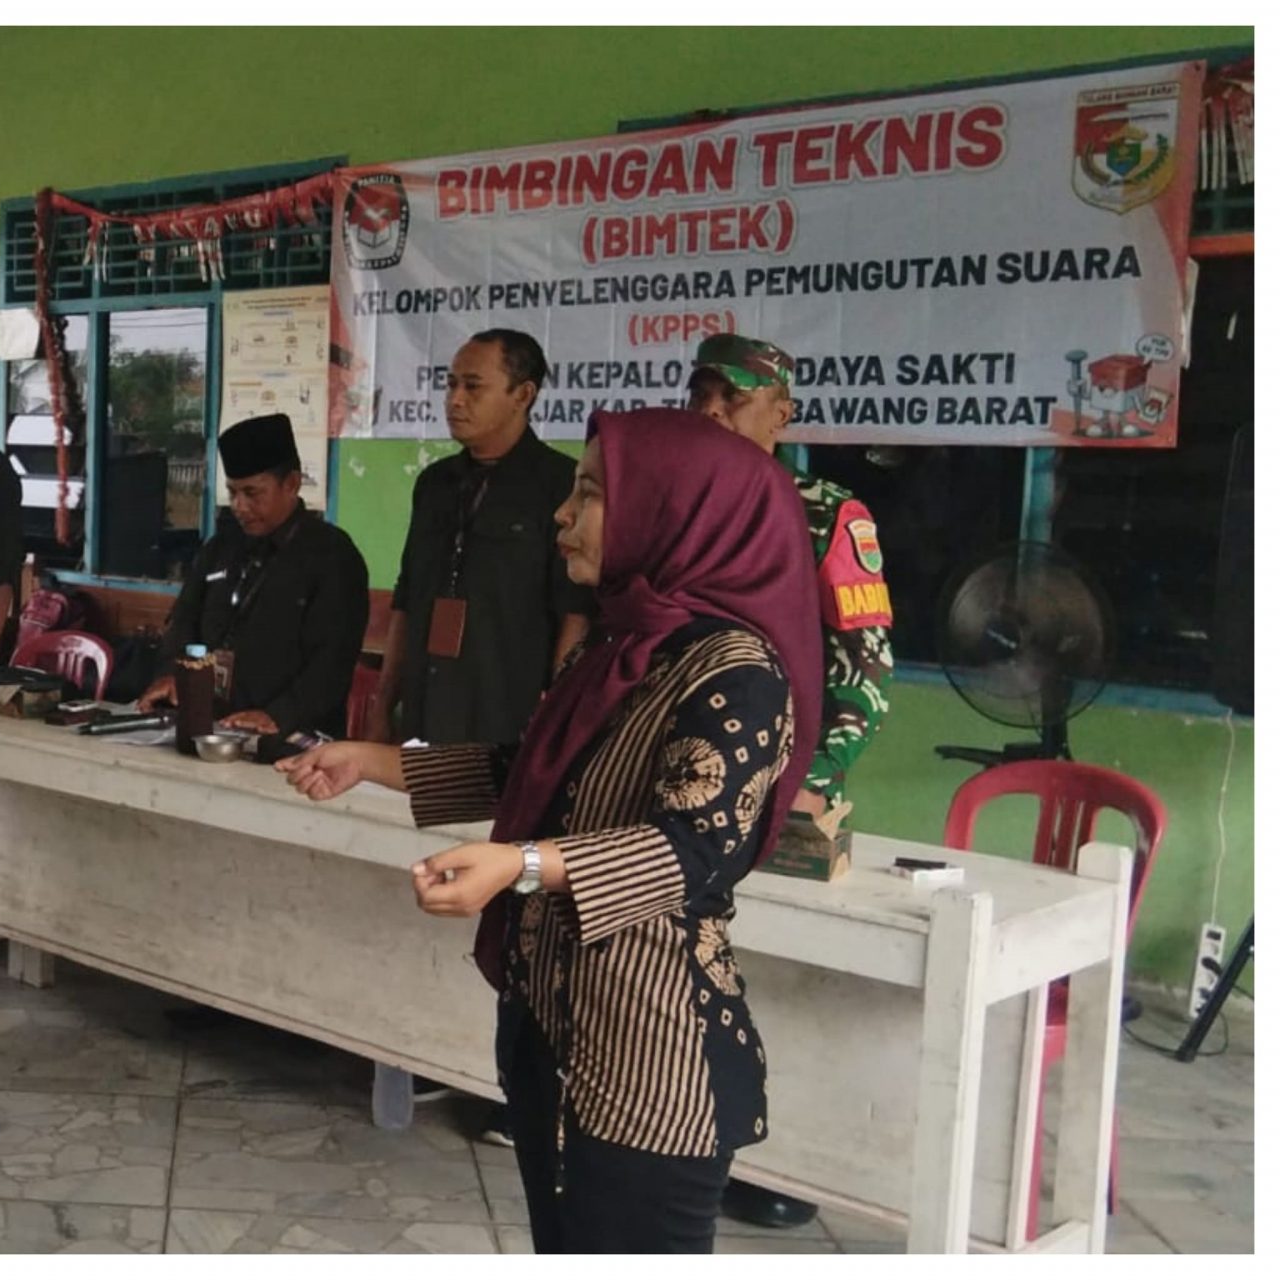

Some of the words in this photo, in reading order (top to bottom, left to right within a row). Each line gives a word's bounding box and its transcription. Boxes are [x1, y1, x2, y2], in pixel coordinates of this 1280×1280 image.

[437, 136, 738, 218] BIMBINGAN
[753, 106, 1005, 187] TEKNIS
[582, 199, 794, 264] (BIMTEK)
[353, 285, 481, 316] KELOMPOK
[489, 270, 736, 310] PENYELENGGARA
[745, 254, 987, 297] PEMUNGUTAN
[997, 245, 1142, 284] SUARA
[628, 310, 736, 346] (KPPS)
[566, 360, 683, 389] KEPALO
[794, 355, 885, 386] DAYA
[896, 352, 1015, 385] SAKTI
[389, 400, 438, 423] KEC.
[792, 397, 927, 425] BAWANG
[933, 396, 1058, 425] BARAT
